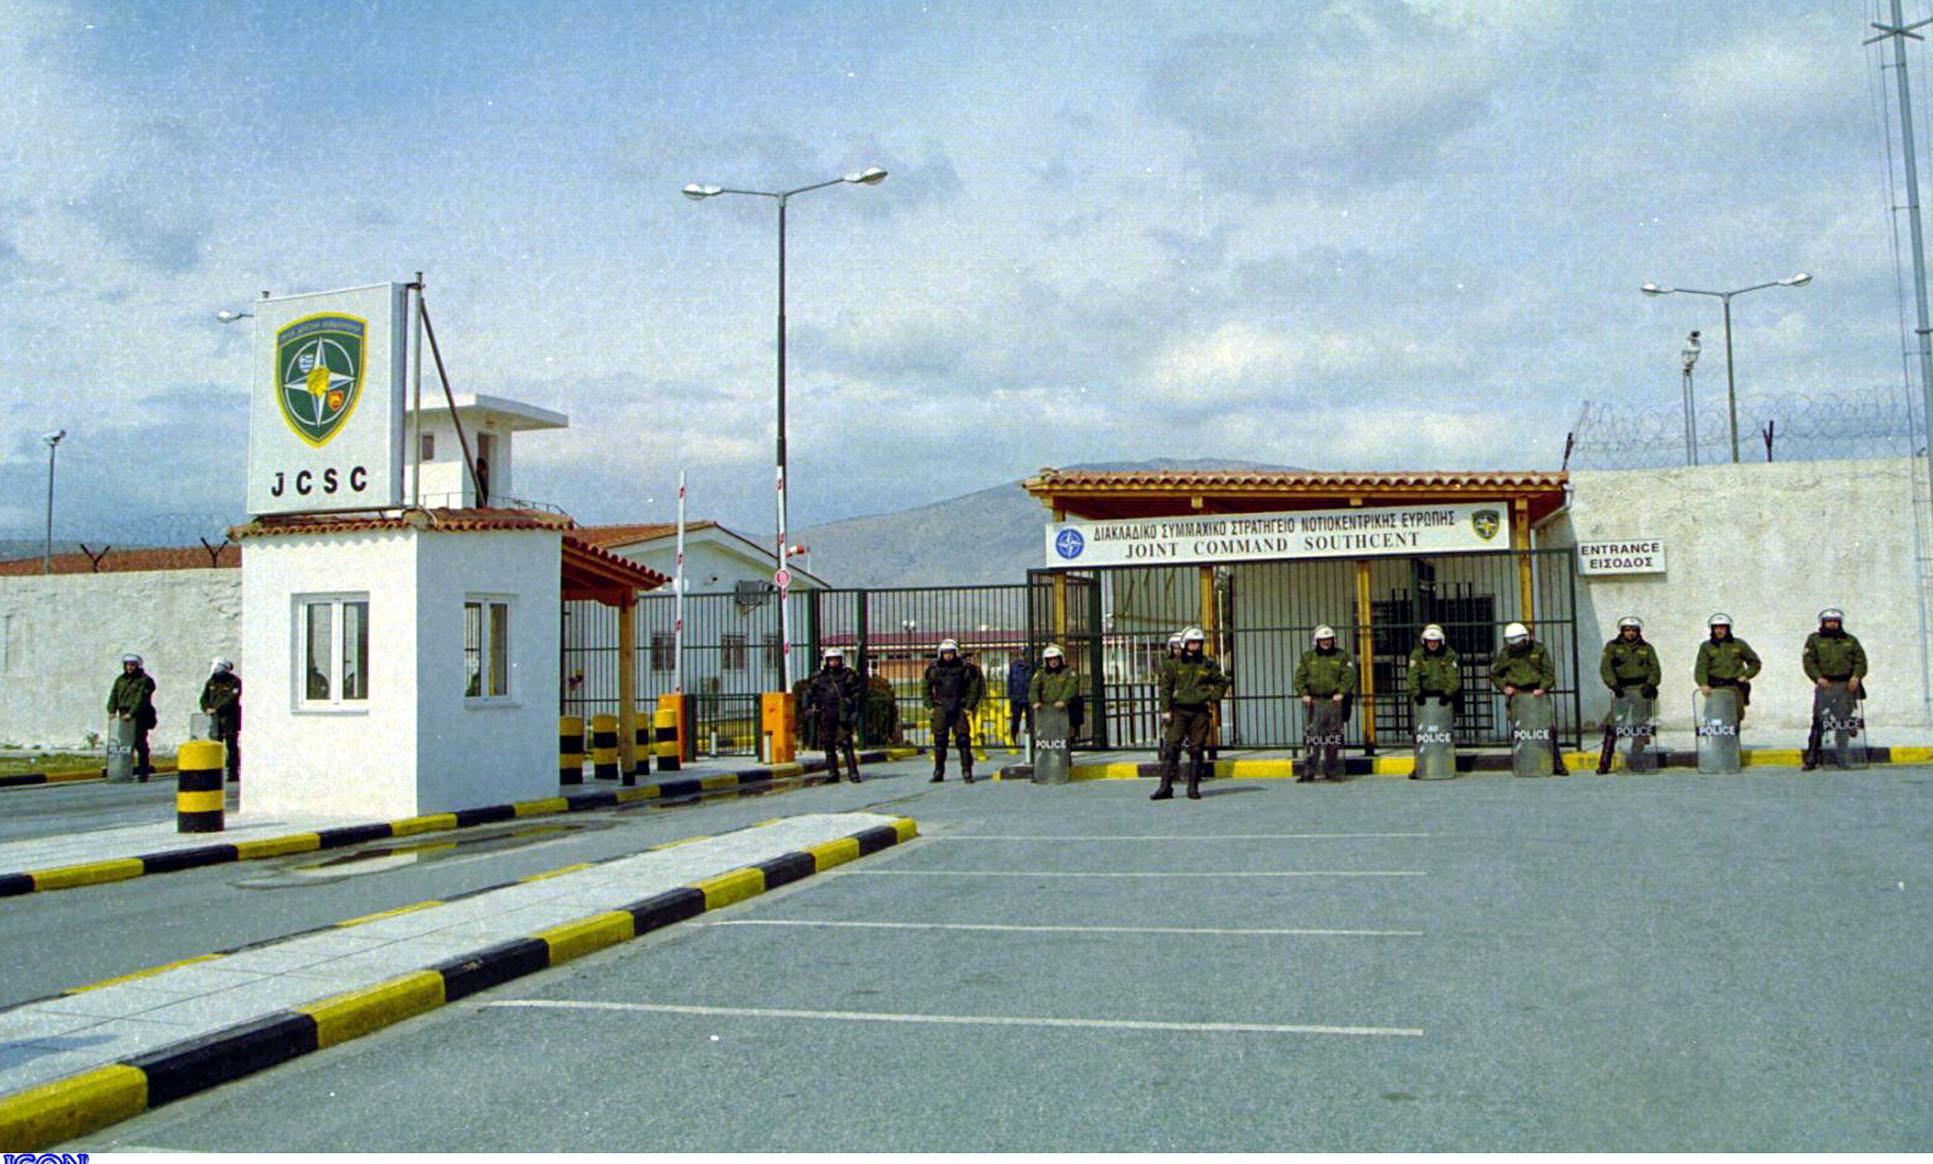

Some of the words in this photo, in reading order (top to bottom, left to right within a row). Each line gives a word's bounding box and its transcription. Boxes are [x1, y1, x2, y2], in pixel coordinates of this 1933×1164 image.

[271, 466, 367, 497] JCSC
[1094, 524, 1157, 541] ΔΙΑΚΛΑΔΙΚΟ
[1162, 520, 1226, 538] ΣΥΜΜΑΧΙΚΟ
[1232, 517, 1295, 535] ΣΤΡΑΤΗΓΕΙΟ
[1301, 512, 1396, 532] ΝΟΤΙΟΚΕΝΤΡΙΚΗΣ
[1402, 510, 1455, 528] ΕΥΡΩΠΗΣ
[1126, 542, 1179, 558] JOINT
[1194, 537, 1288, 555] COMMAND
[1304, 532, 1420, 550] SOUTHCENT
[1581, 543, 1660, 555] ENTRANCE
[1590, 557, 1653, 568] ΕΙΣΟΔΟΣ
[1514, 729, 1550, 739] POLICE
[1616, 726, 1652, 736] POLICE
[1699, 726, 1735, 736] POLICE
[1306, 734, 1342, 745] POLICE
[1416, 733, 1451, 743] POLICE
[1036, 739, 1066, 749] POLICE
